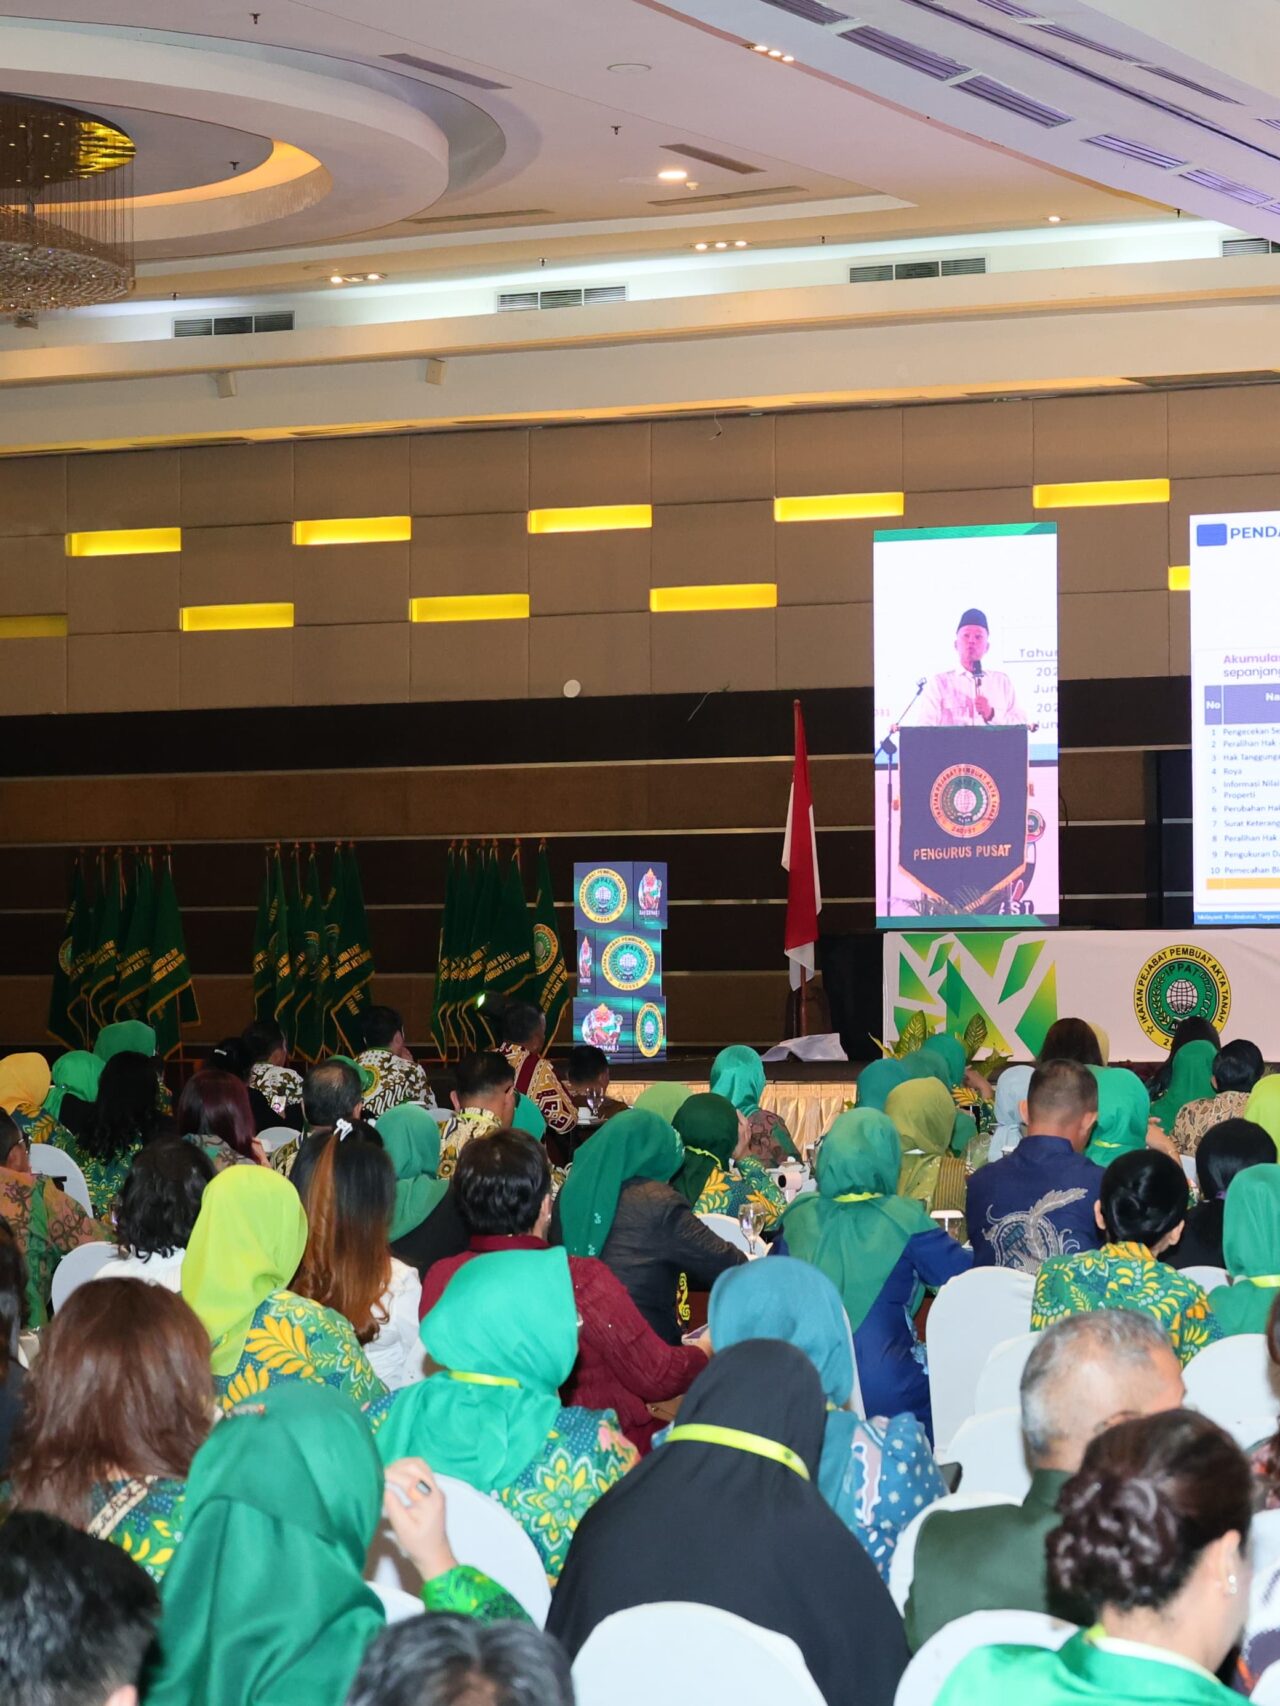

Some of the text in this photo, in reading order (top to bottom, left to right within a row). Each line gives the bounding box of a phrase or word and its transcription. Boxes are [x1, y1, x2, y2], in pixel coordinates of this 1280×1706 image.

[1206, 701, 1221, 710] No
[913, 843, 1012, 861] PENGURUS PUSAT
[1165, 962, 1201, 977] IPPAT
[1136, 947, 1229, 1024] IKATAN PEJABAT PEMBUAT AKTA TANAH
